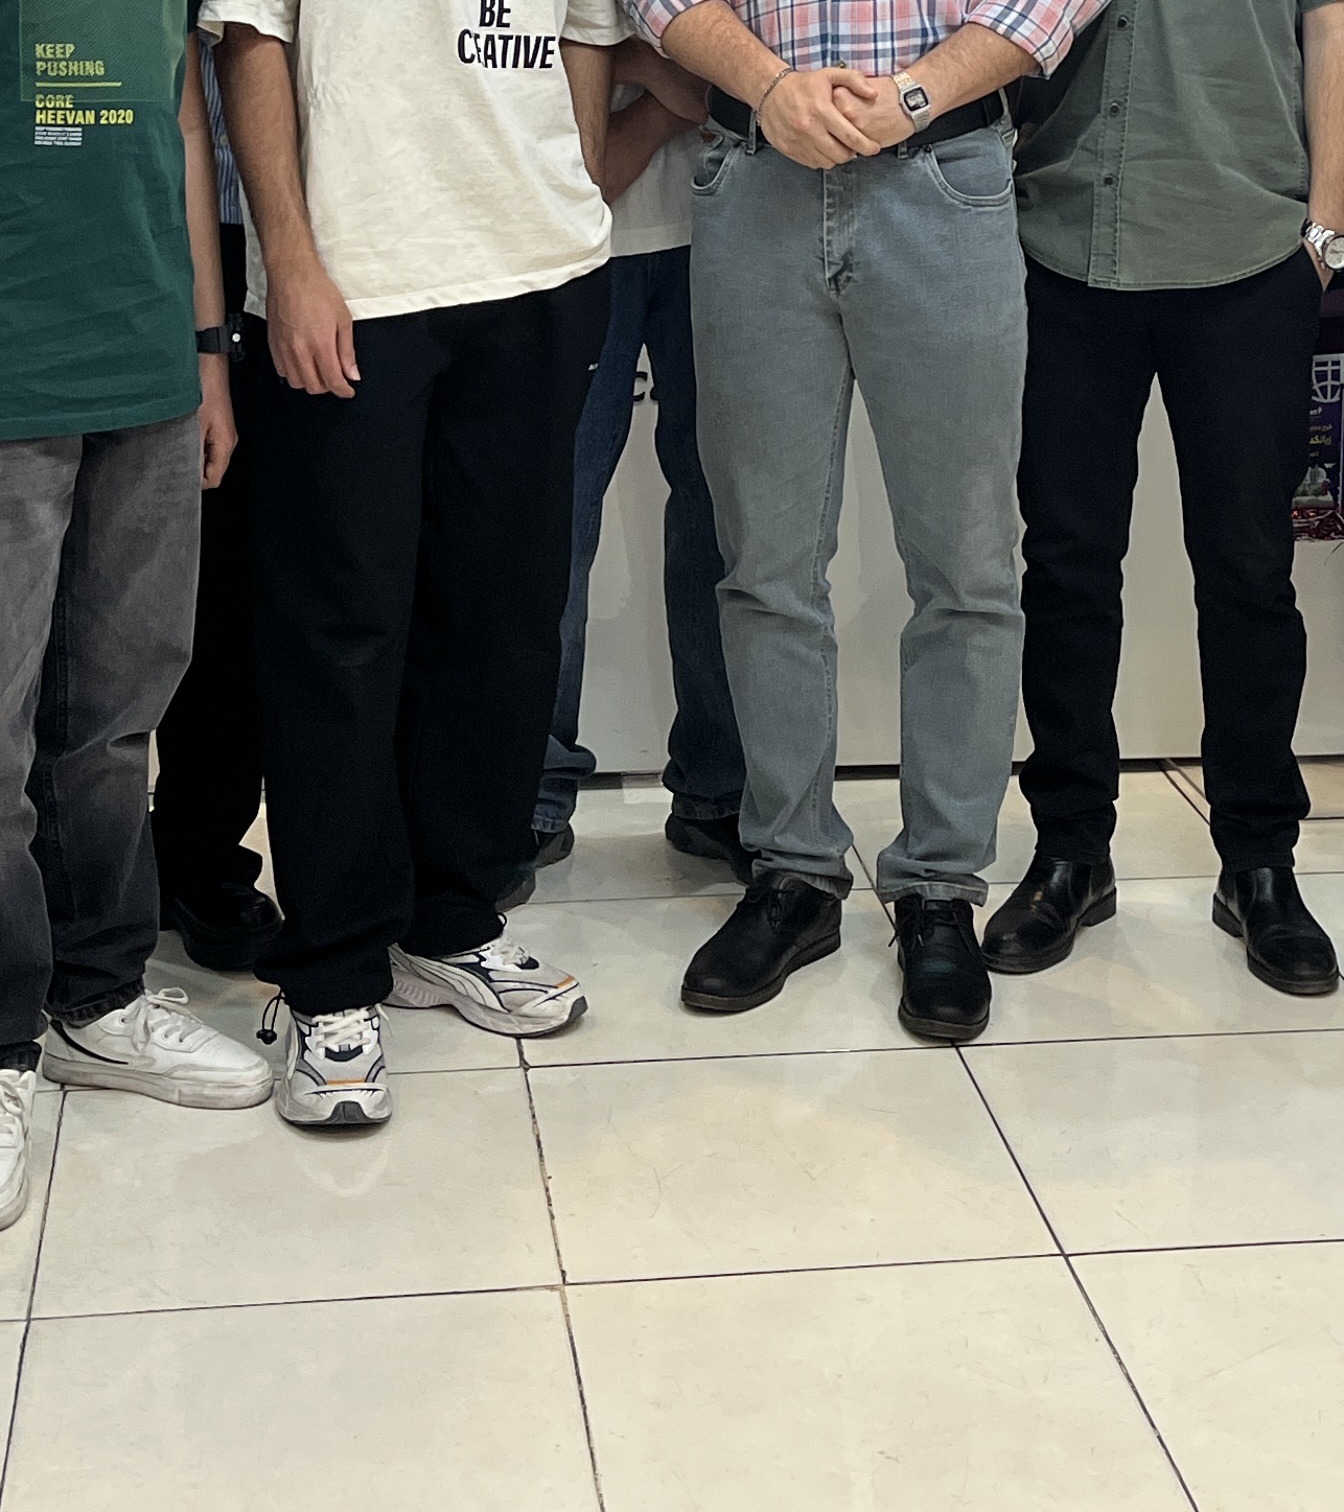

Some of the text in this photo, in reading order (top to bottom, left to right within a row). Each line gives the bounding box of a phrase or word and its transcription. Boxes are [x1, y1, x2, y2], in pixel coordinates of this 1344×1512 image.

[35, 43, 75, 59] KEEP
[35, 60, 105, 77] PUSHING
[35, 94, 74, 109] CORE
[35, 109, 135, 125] HEEVAN 2020
